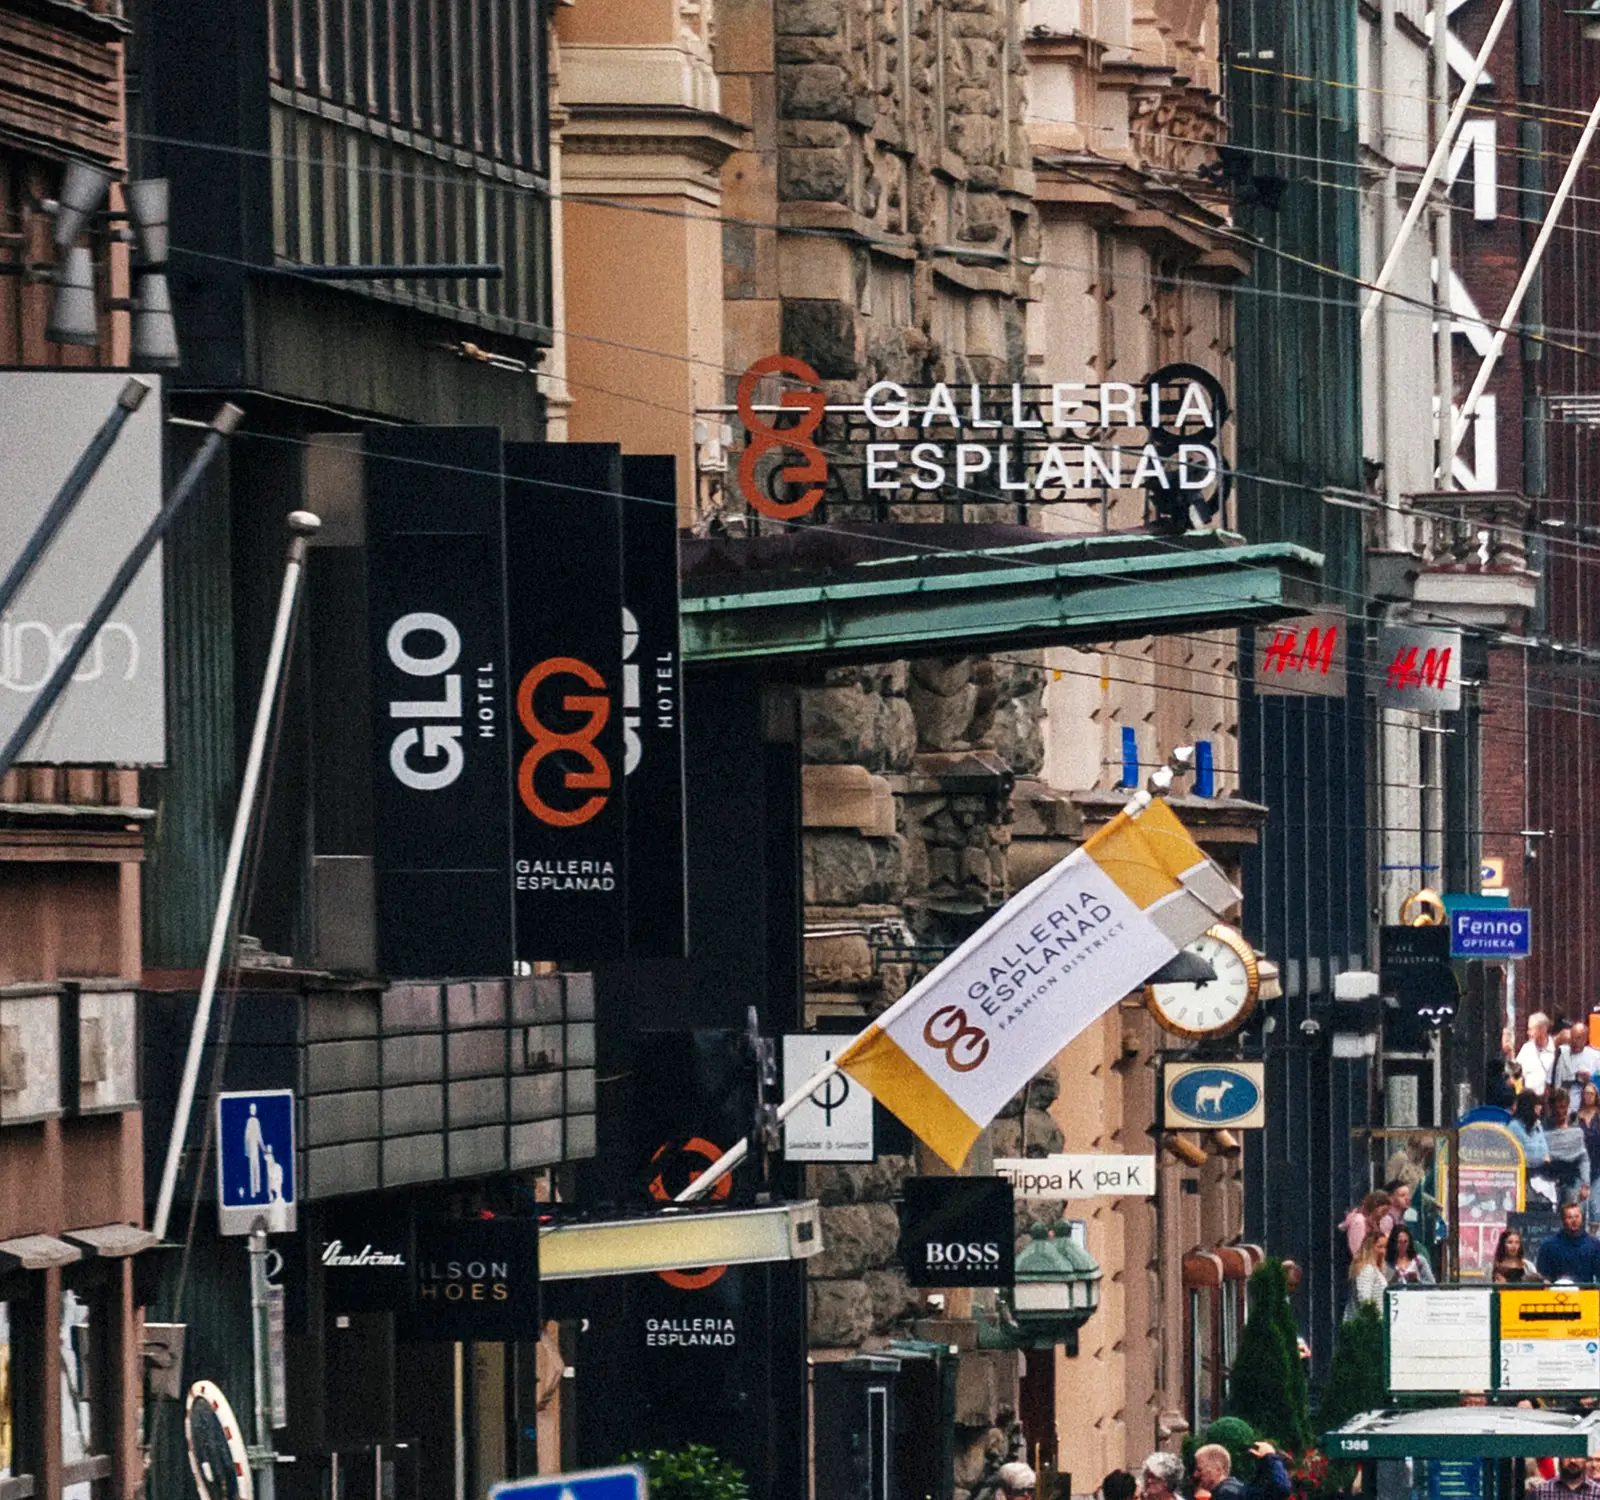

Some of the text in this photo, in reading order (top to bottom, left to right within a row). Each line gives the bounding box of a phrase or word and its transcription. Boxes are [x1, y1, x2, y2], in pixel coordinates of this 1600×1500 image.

[862, 380, 1213, 428] GALLERIA
[864, 442, 1217, 491] ESPLANAD
[1265, 624, 1337, 674] H&M
[1386, 645, 1451, 690] H&M
[386, 611, 465, 792] GLO
[479, 660, 494, 738] HOTEL
[658, 651, 673, 729] HOTEL
[516, 860, 614, 876] GALLERIA
[516, 876, 616, 891] ESPLANAD
[967, 891, 1098, 1000] GALLERIA
[1458, 917, 1522, 935] Fenno
[980, 904, 1111, 1017] ESPLANAD
[999, 921, 1126, 1029] FASHION DISTRICT
[997, 1169, 1063, 1191] ilippa
[925, 1243, 999, 1262] BOSS
[646, 1319, 734, 1331] GALLERIA
[646, 1334, 735, 1346] ESPLANAD
[1502, 1359, 1510, 1371] 2
